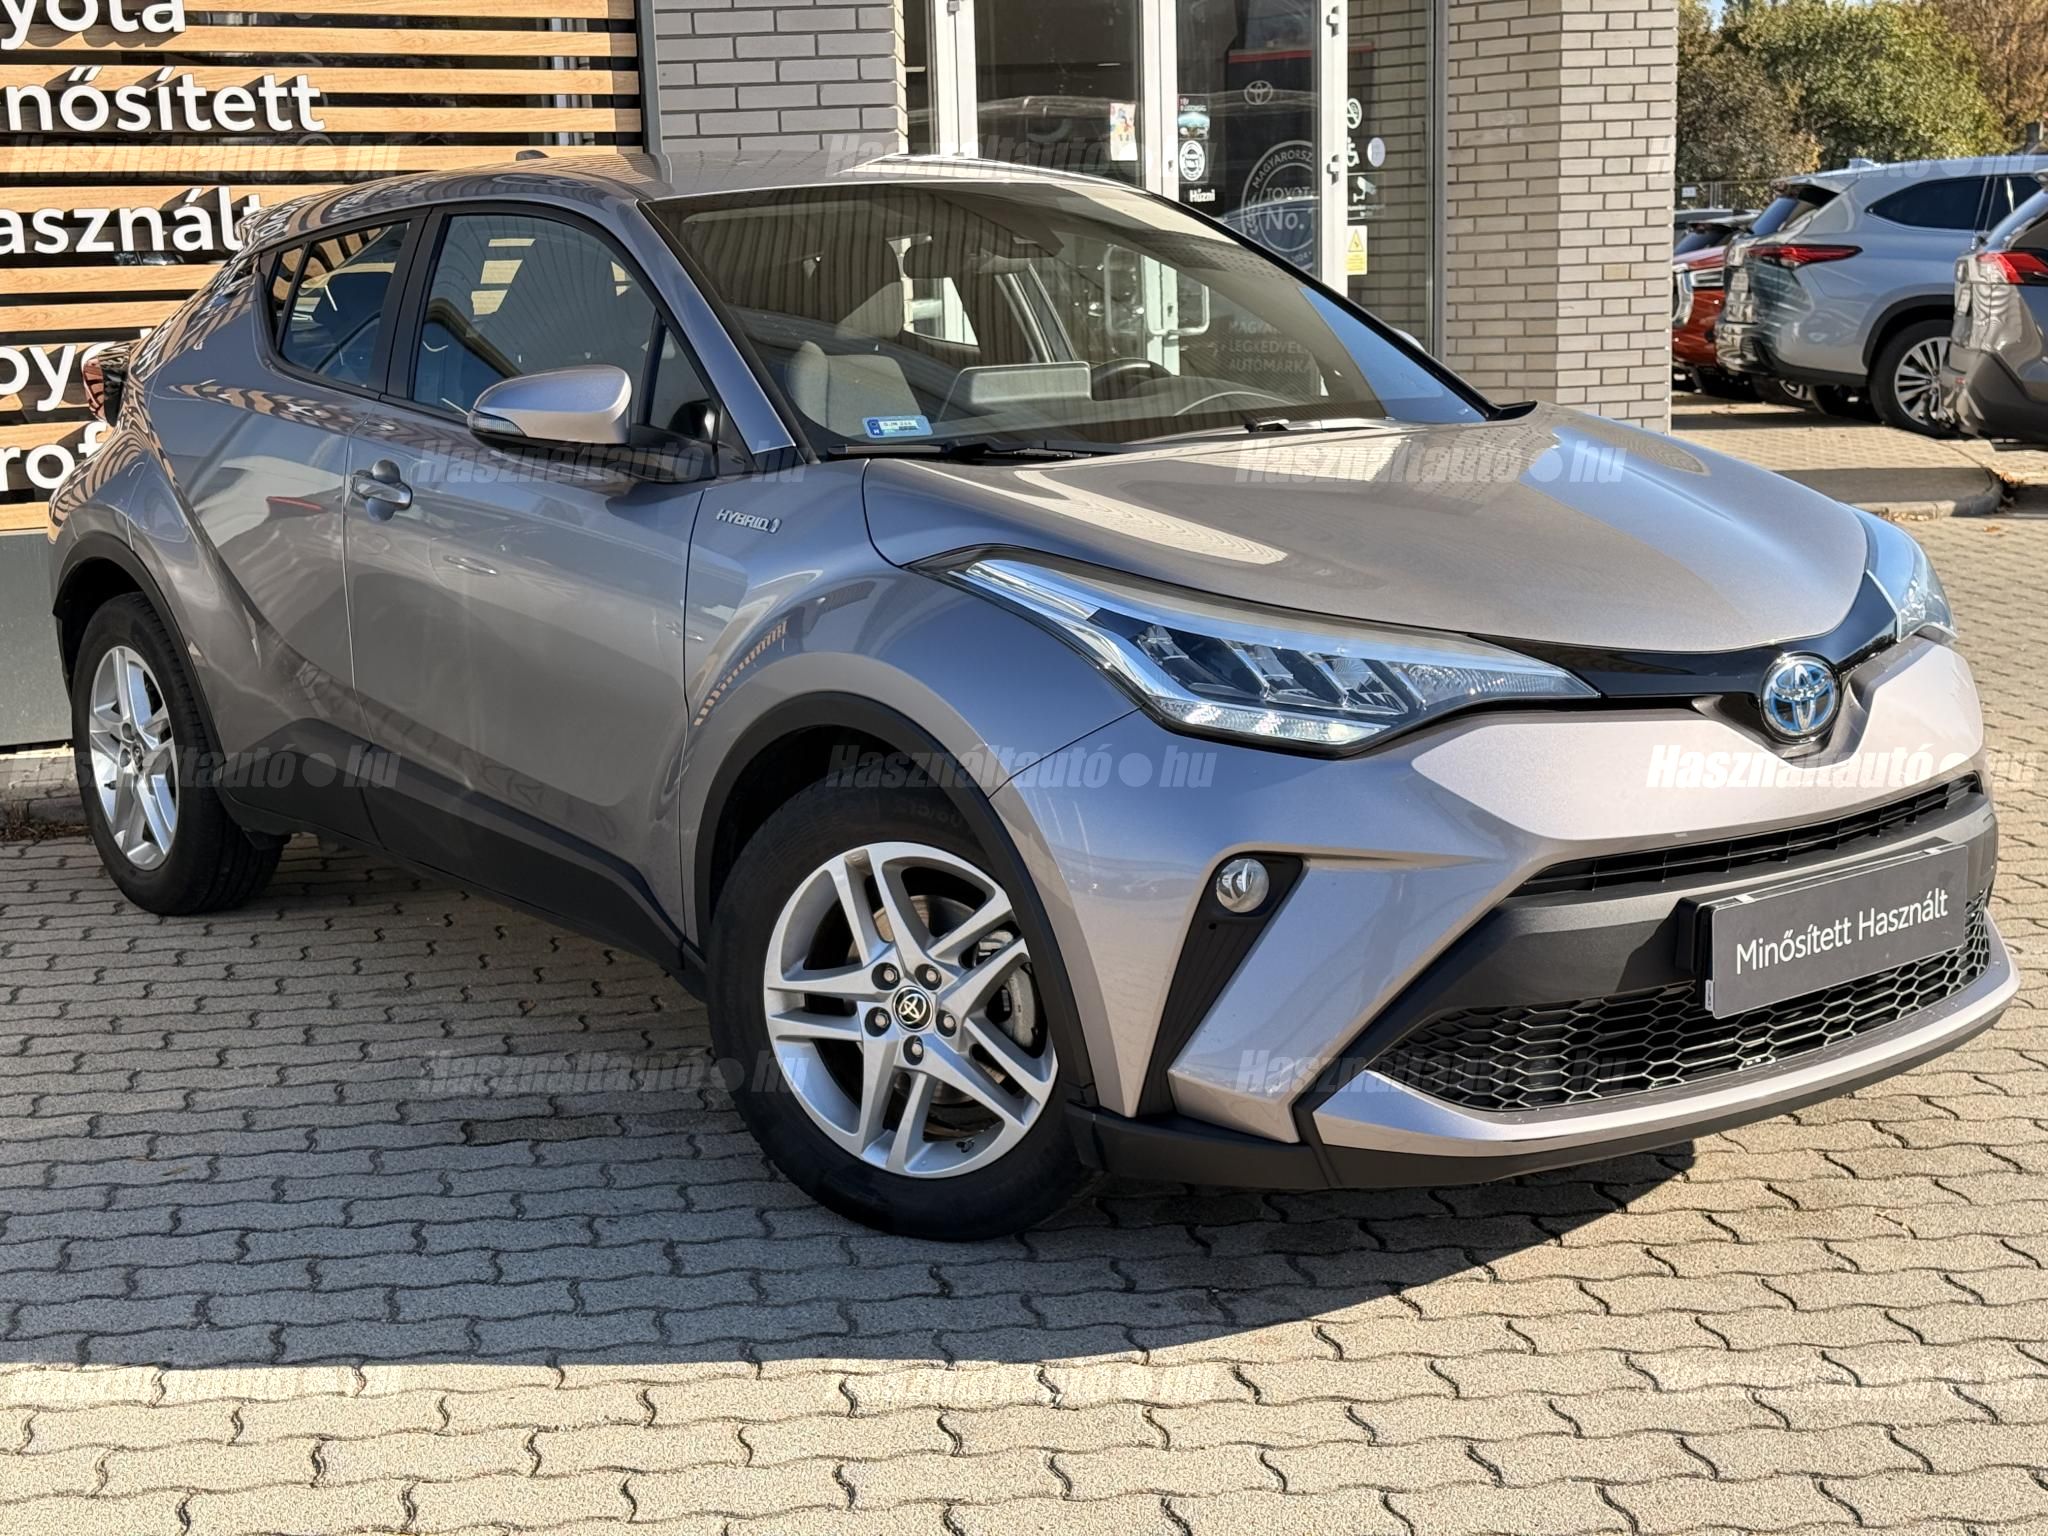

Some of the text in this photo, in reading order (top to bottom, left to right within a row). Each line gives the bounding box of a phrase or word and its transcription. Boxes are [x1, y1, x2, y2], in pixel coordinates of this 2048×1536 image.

[5, 66, 326, 132] nősített
[716, 508, 769, 531] HYBRID
[1736, 888, 1948, 974] Minősített Használt
